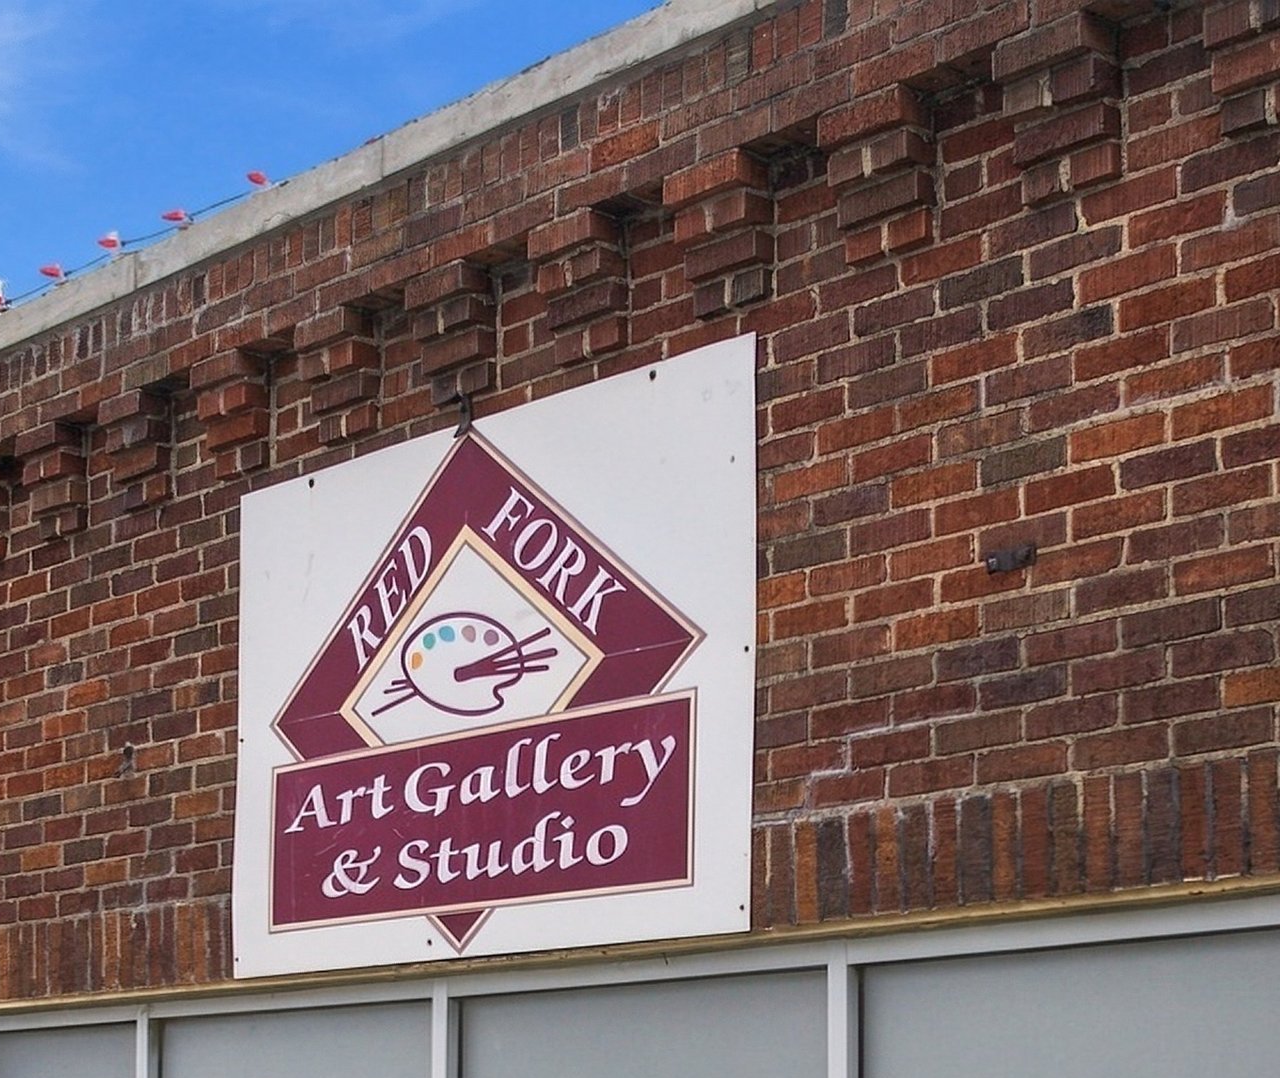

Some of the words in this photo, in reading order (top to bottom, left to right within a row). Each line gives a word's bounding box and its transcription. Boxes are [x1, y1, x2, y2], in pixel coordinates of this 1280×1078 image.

[347, 525, 433, 674] RED
[481, 486, 627, 636] FORK
[284, 773, 396, 835] Art
[403, 732, 677, 817] Gallery
[321, 845, 382, 899] &
[393, 810, 629, 890] Studio
